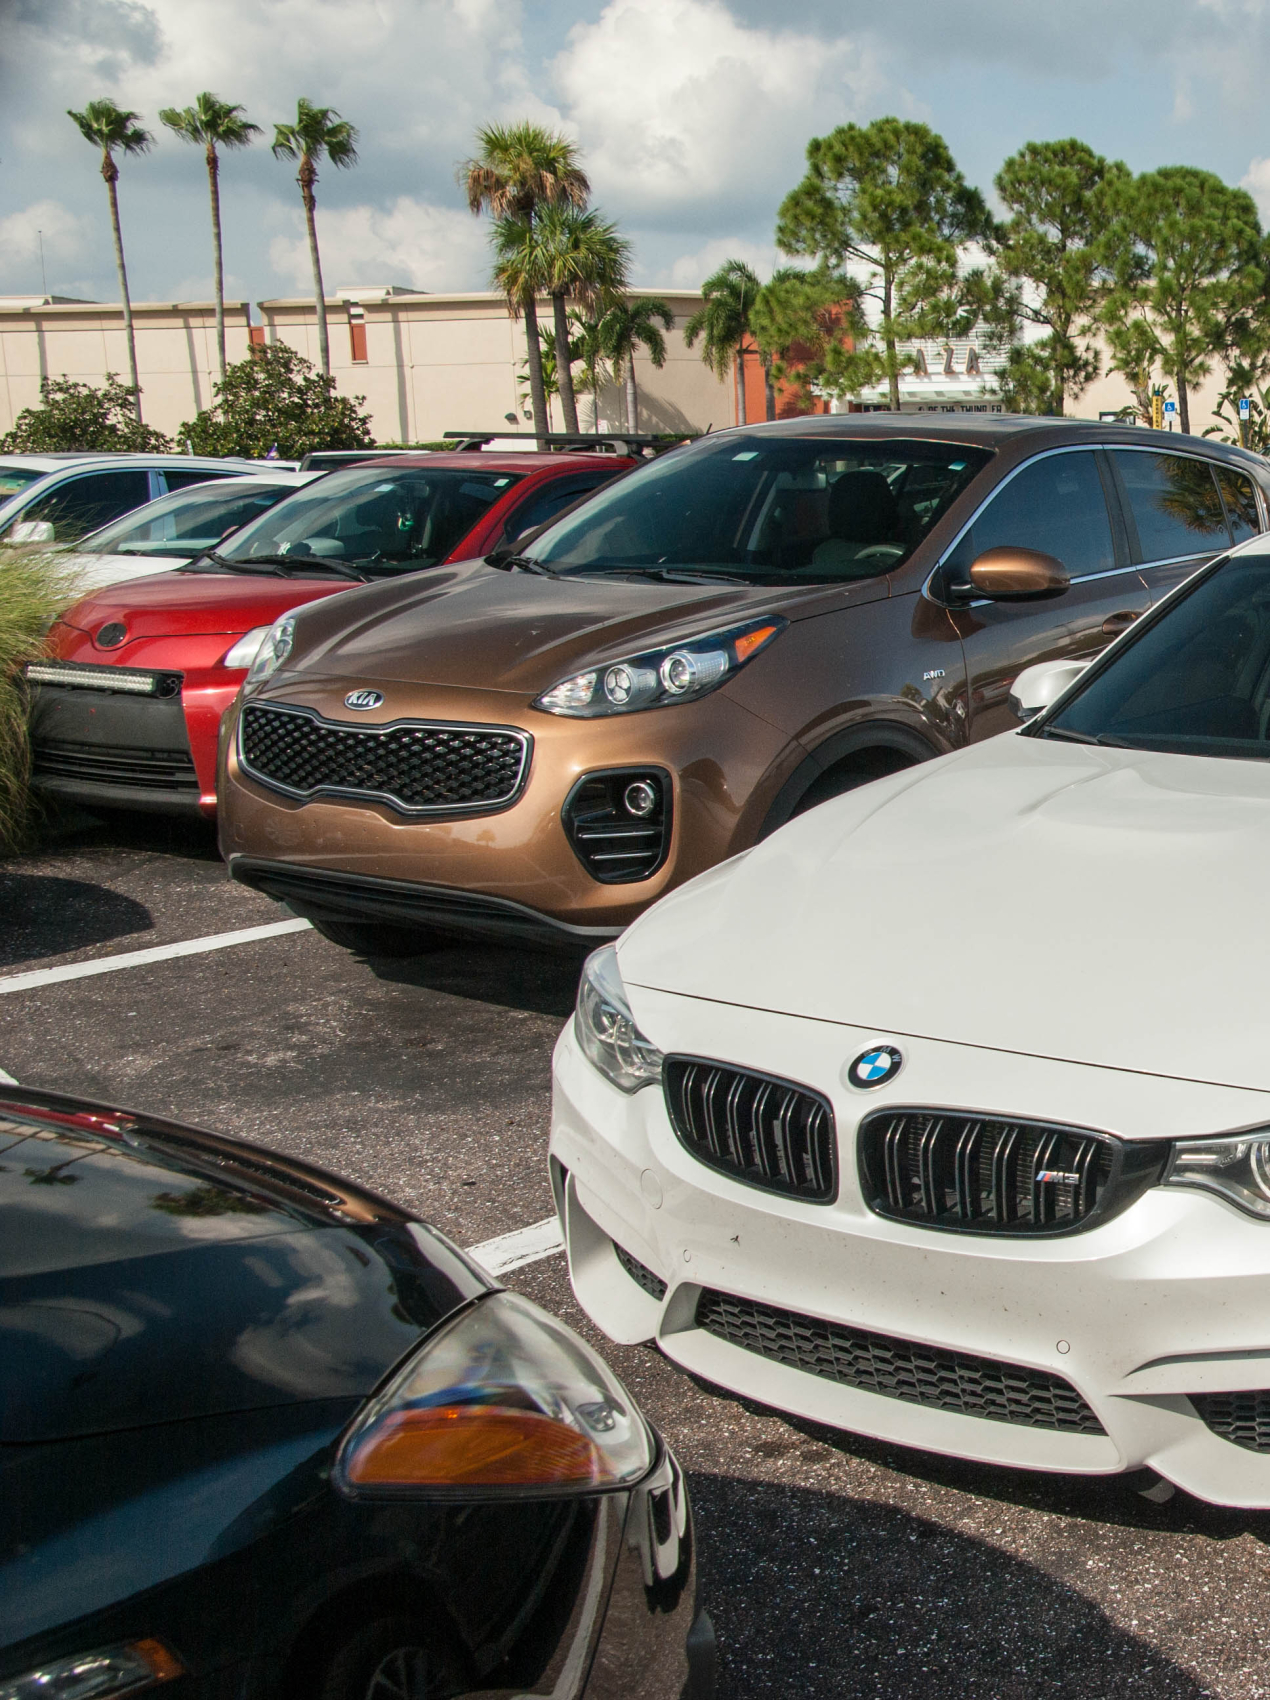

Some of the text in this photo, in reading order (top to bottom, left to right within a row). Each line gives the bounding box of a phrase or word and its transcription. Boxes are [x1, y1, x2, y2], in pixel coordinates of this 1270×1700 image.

[923, 669, 945, 680] AWD
[348, 692, 377, 706] KIA
[863, 1046, 902, 1063] BMW
